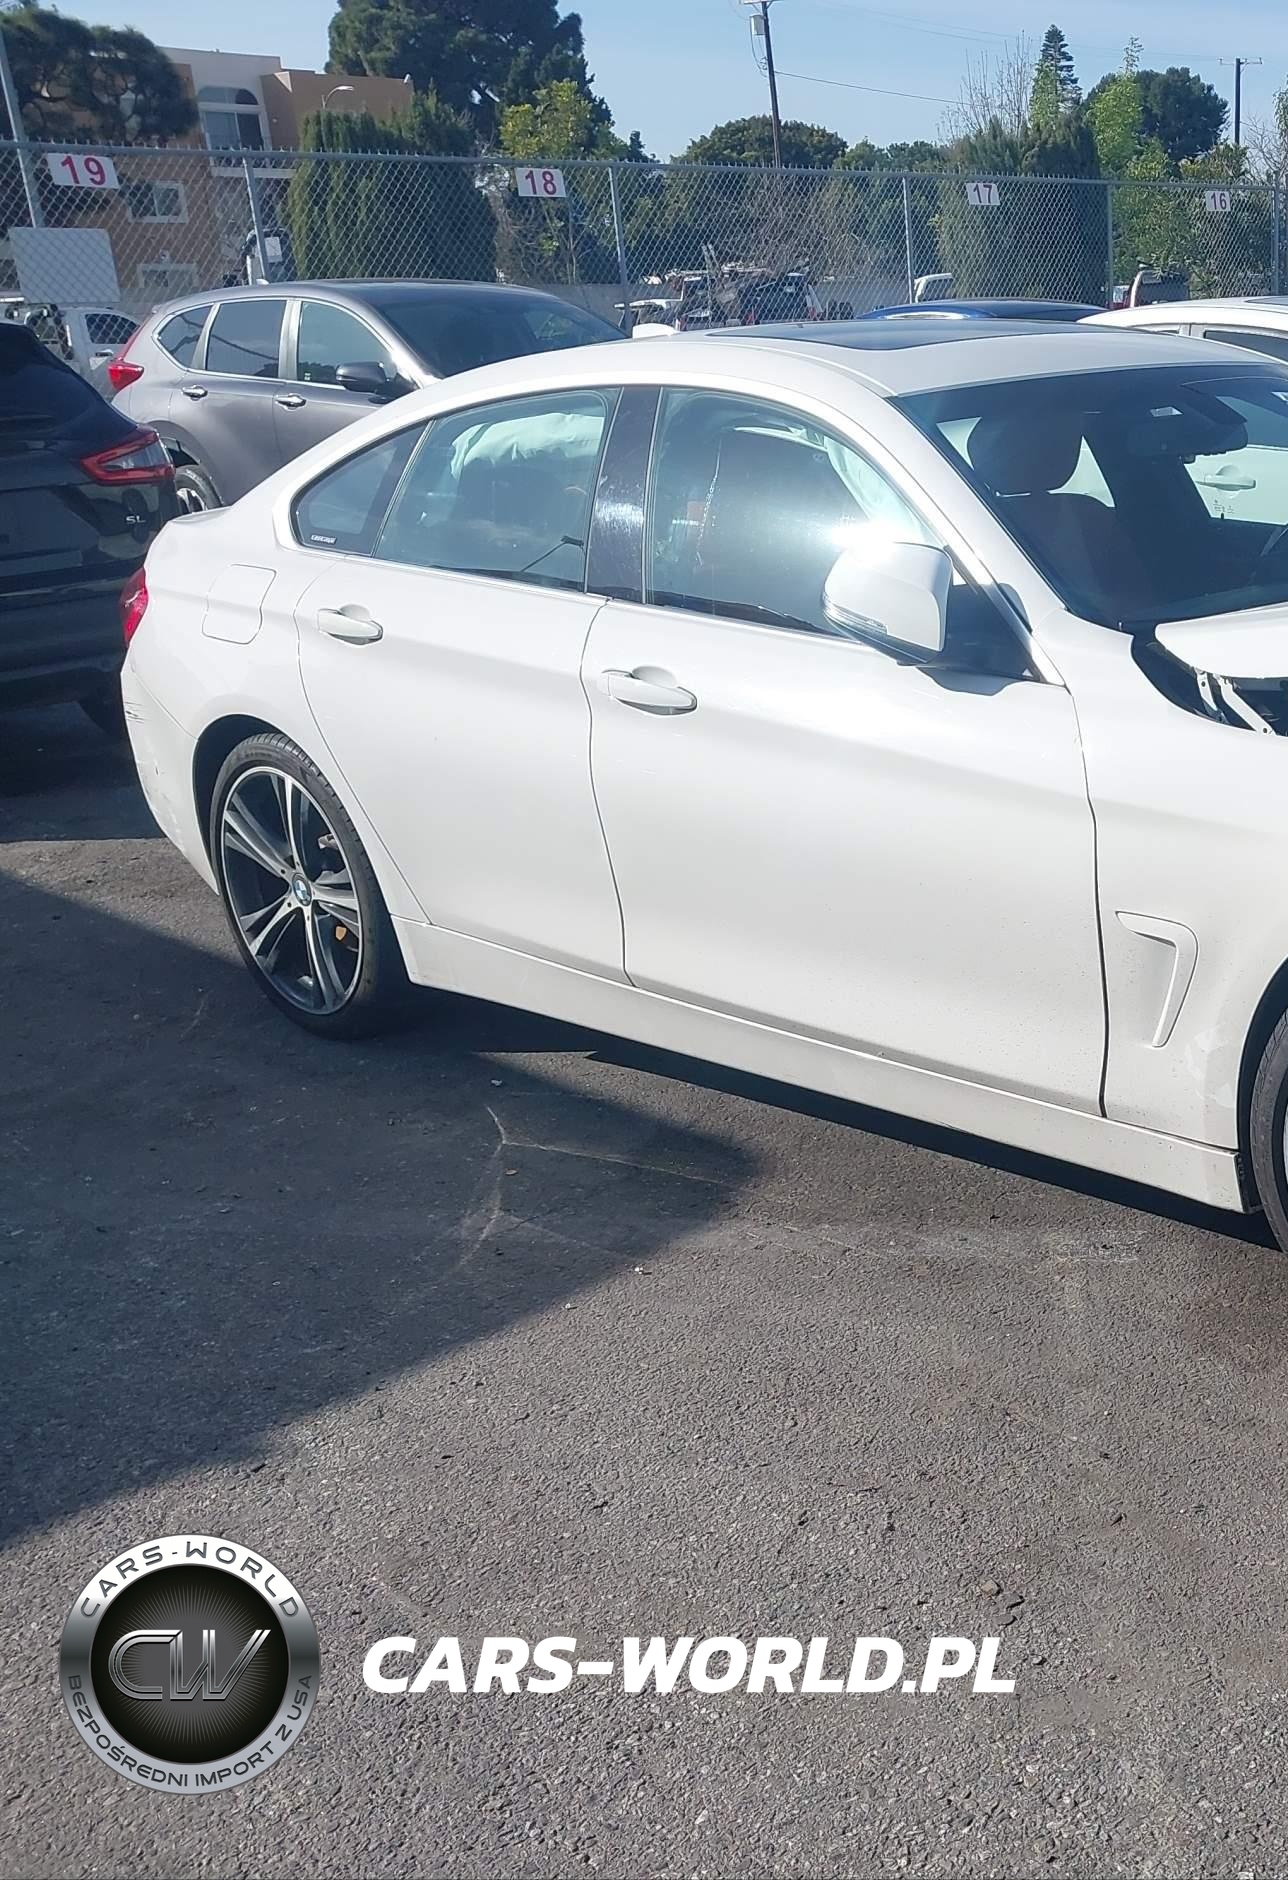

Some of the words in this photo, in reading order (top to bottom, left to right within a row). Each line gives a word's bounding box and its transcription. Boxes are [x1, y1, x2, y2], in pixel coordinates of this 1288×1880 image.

[60, 155, 106, 186] 19
[525, 169, 557, 196] 18
[972, 183, 993, 204] 17
[1210, 191, 1227, 210] 16
